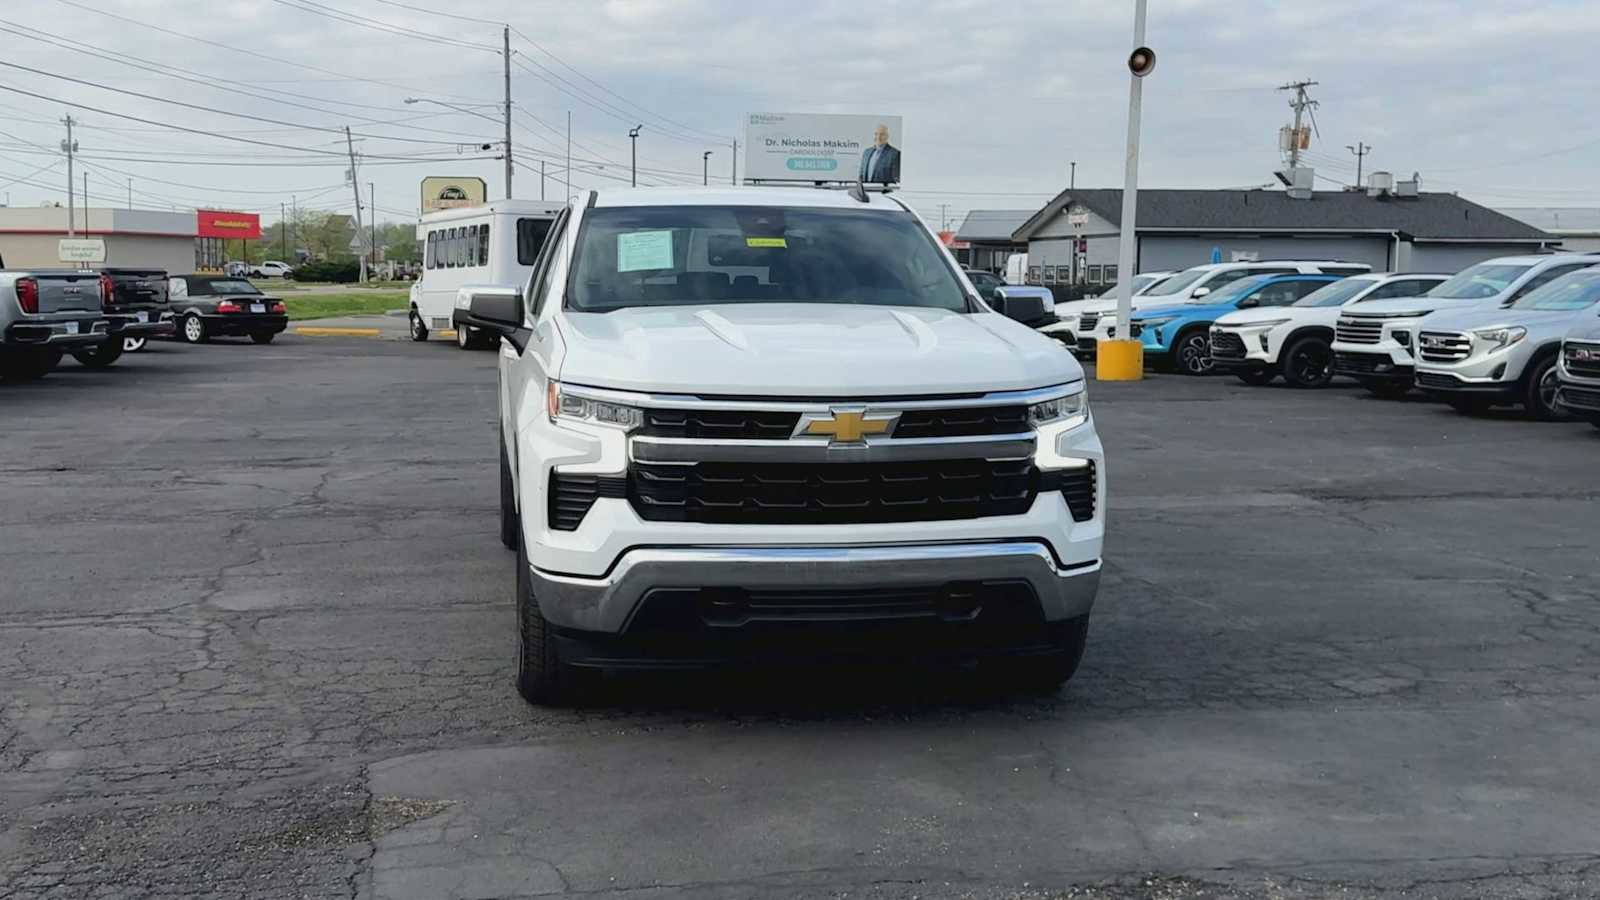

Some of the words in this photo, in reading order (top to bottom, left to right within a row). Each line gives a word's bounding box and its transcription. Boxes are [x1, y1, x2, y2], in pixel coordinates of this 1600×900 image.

[765, 138, 779, 146] Dr.
[781, 138, 821, 147] Nicholas
[823, 140, 860, 148] Maksim
